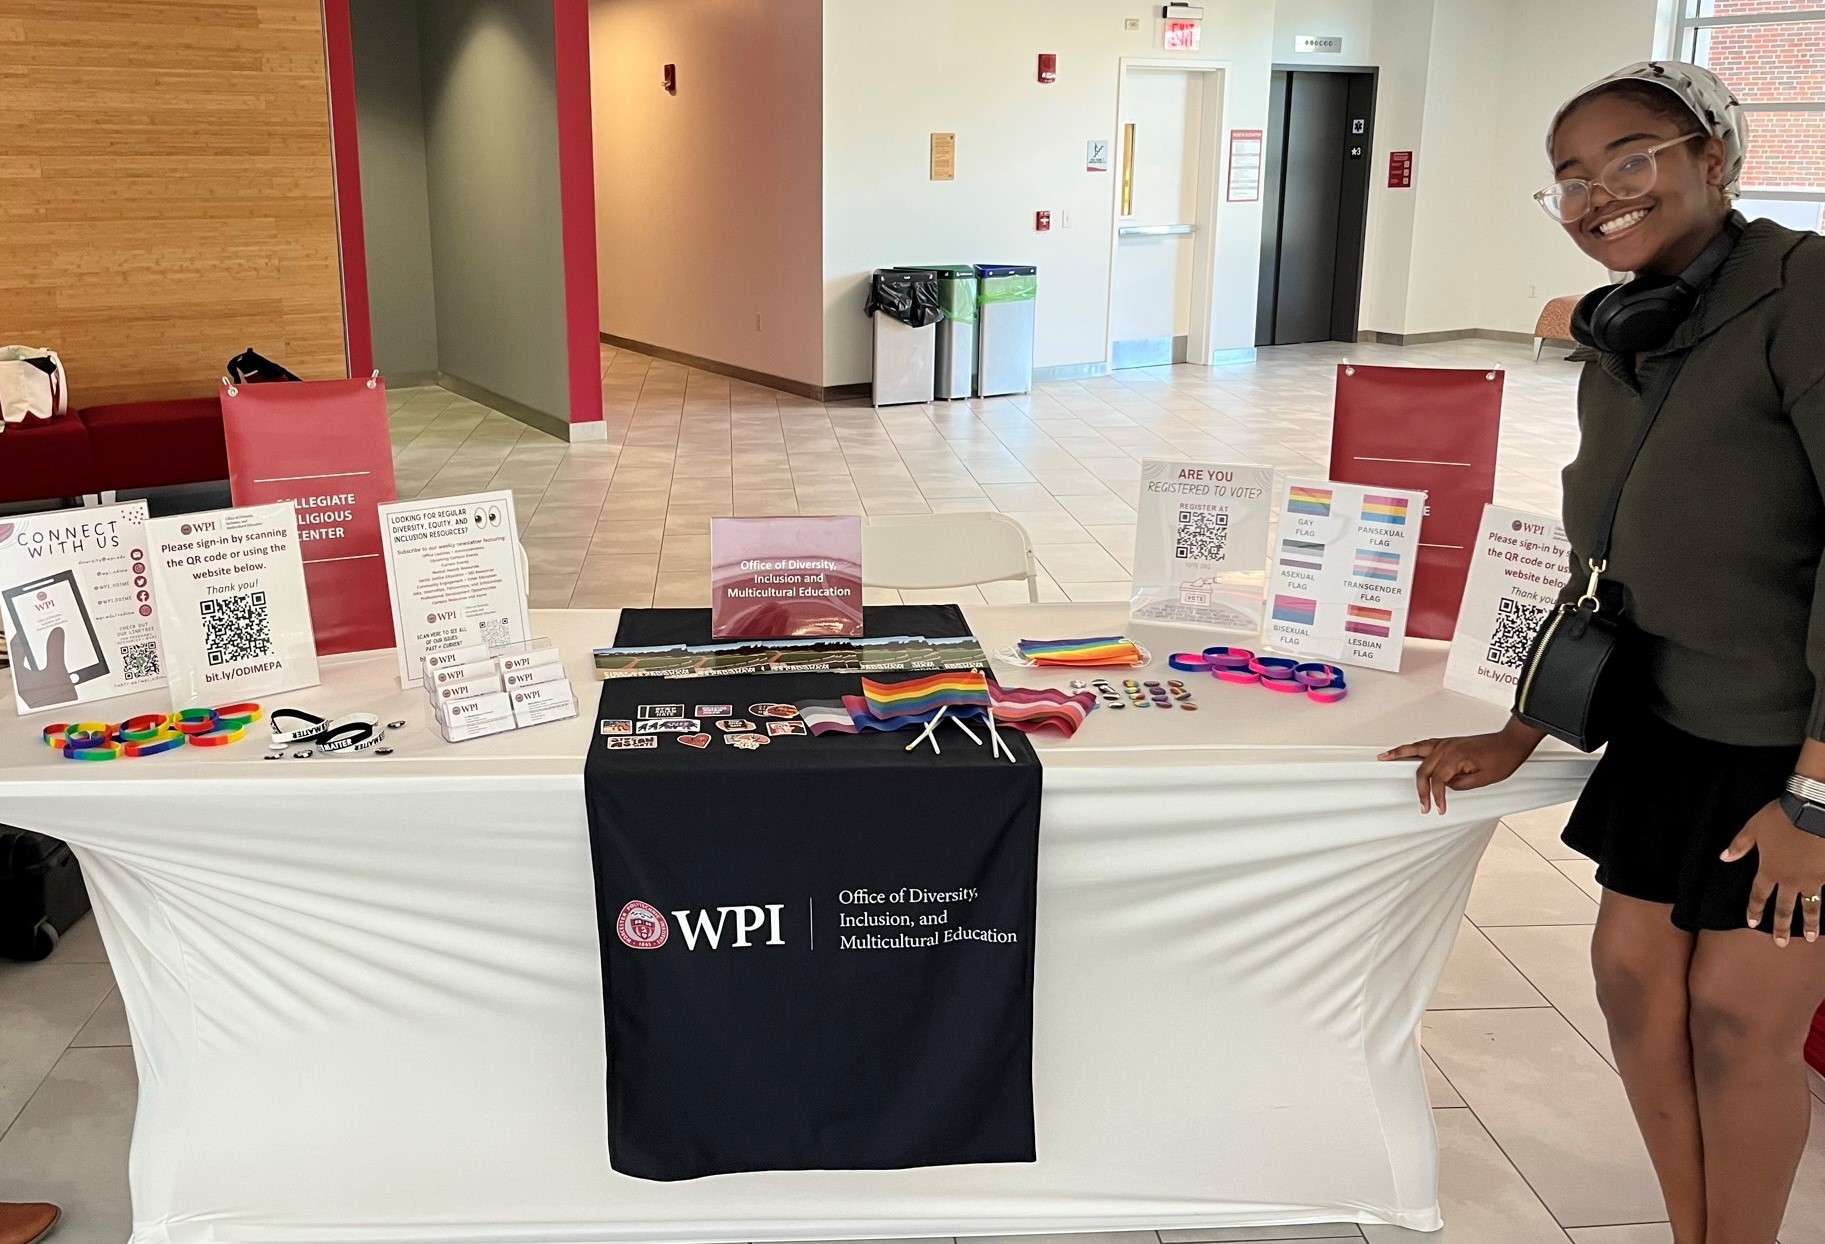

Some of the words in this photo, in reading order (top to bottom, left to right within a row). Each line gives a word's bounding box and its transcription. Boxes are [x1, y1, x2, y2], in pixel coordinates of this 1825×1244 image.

[1178, 469, 1203, 480] ARE
[1208, 471, 1233, 482] YOU
[1148, 481, 1209, 496] REGISTERED
[1214, 486, 1226, 496] TO
[1230, 487, 1262, 499] VOTE?
[277, 494, 355, 508] LLEGIATE
[1180, 503, 1216, 511] REGISTER
[296, 510, 352, 525] LIGIOUS
[391, 514, 421, 524] LOOKING
[438, 508, 466, 518] REGULAR
[193, 521, 216, 532] WPI
[393, 523, 427, 533] DIVERSITY,
[429, 521, 453, 529] EQUITY,
[1358, 526, 1405, 538] PANSEXUAL
[1524, 523, 1545, 535] WPI
[18, 520, 117, 546] CONNECT
[297, 527, 344, 541] ENTER
[394, 533, 428, 543] INCLUSION
[430, 527, 468, 538] RESOURCES?
[1296, 529, 1315, 537] FLAG
[28, 539, 84, 559] WITH
[97, 535, 119, 548] US
[161, 542, 194, 553] Please
[196, 536, 229, 549] sign-in
[231, 534, 243, 544] by
[246, 529, 287, 540] scanning
[1370, 538, 1390, 547] FLAG
[1488, 532, 1517, 546] Please
[1519, 539, 1550, 553] sign-in
[1552, 545, 1564, 558] by
[167, 559, 184, 568] the
[186, 555, 201, 566] QR
[204, 552, 227, 562] code
[230, 551, 240, 559] or
[243, 546, 268, 556] using
[271, 543, 286, 552] the
[397, 548, 420, 556] Subscribe
[1488, 547, 1502, 558] the
[1504, 552, 1518, 562] QR
[1520, 557, 1543, 567] code
[1545, 562, 1556, 570] or
[192, 565, 231, 580] website
[234, 562, 267, 573] below.
[740, 560, 772, 570] Office
[774, 560, 786, 569] of
[789, 560, 837, 570] Diversity,
[754, 574, 801, 583] Inclusion
[804, 573, 824, 583] and
[1281, 571, 1315, 581] ASEXUAL
[1504, 568, 1541, 582] website
[1543, 576, 1567, 589] belo
[206, 583, 235, 595] Thank
[238, 579, 259, 592] you!
[727, 588, 796, 597] Multicultural
[799, 587, 850, 597] Education
[1288, 582, 1307, 590] FLAG
[1343, 580, 1402, 595] TRANSGENDER
[1361, 594, 1380, 603] FLAG
[1511, 586, 1538, 600] Thank
[1539, 594, 1557, 605] you
[35, 599, 55, 612] WPI
[437, 611, 456, 620] WPI
[129, 626, 154, 635] LINKTREE
[1273, 625, 1309, 636] BISEXUAL
[443, 640, 463, 648] CURRENT
[1280, 637, 1299, 645] FLAG
[1348, 638, 1382, 649] LESBIAN
[439, 654, 456, 664] WPI
[1353, 650, 1373, 659] FLAG
[513, 658, 530, 667] WPI
[206, 661, 282, 682] bit.ly/ODIMEPA
[447, 670, 464, 680] WPI
[1477, 666, 1519, 685] bit.ly/OD
[516, 673, 533, 683] WPI
[451, 686, 468, 696] WPI
[523, 690, 540, 700] WPI
[461, 703, 478, 713] WPI
[291, 724, 321, 738] MATTER
[324, 738, 352, 751] MATTER
[839, 889, 885, 904] Office
[889, 887, 907, 903] of
[909, 887, 978, 903] Diversity,
[840, 912, 915, 927] Inclusion,
[919, 910, 948, 926] and
[671, 904, 785, 951] WPI
[840, 932, 939, 949] Multicultural
[943, 927, 1017, 943] Education
